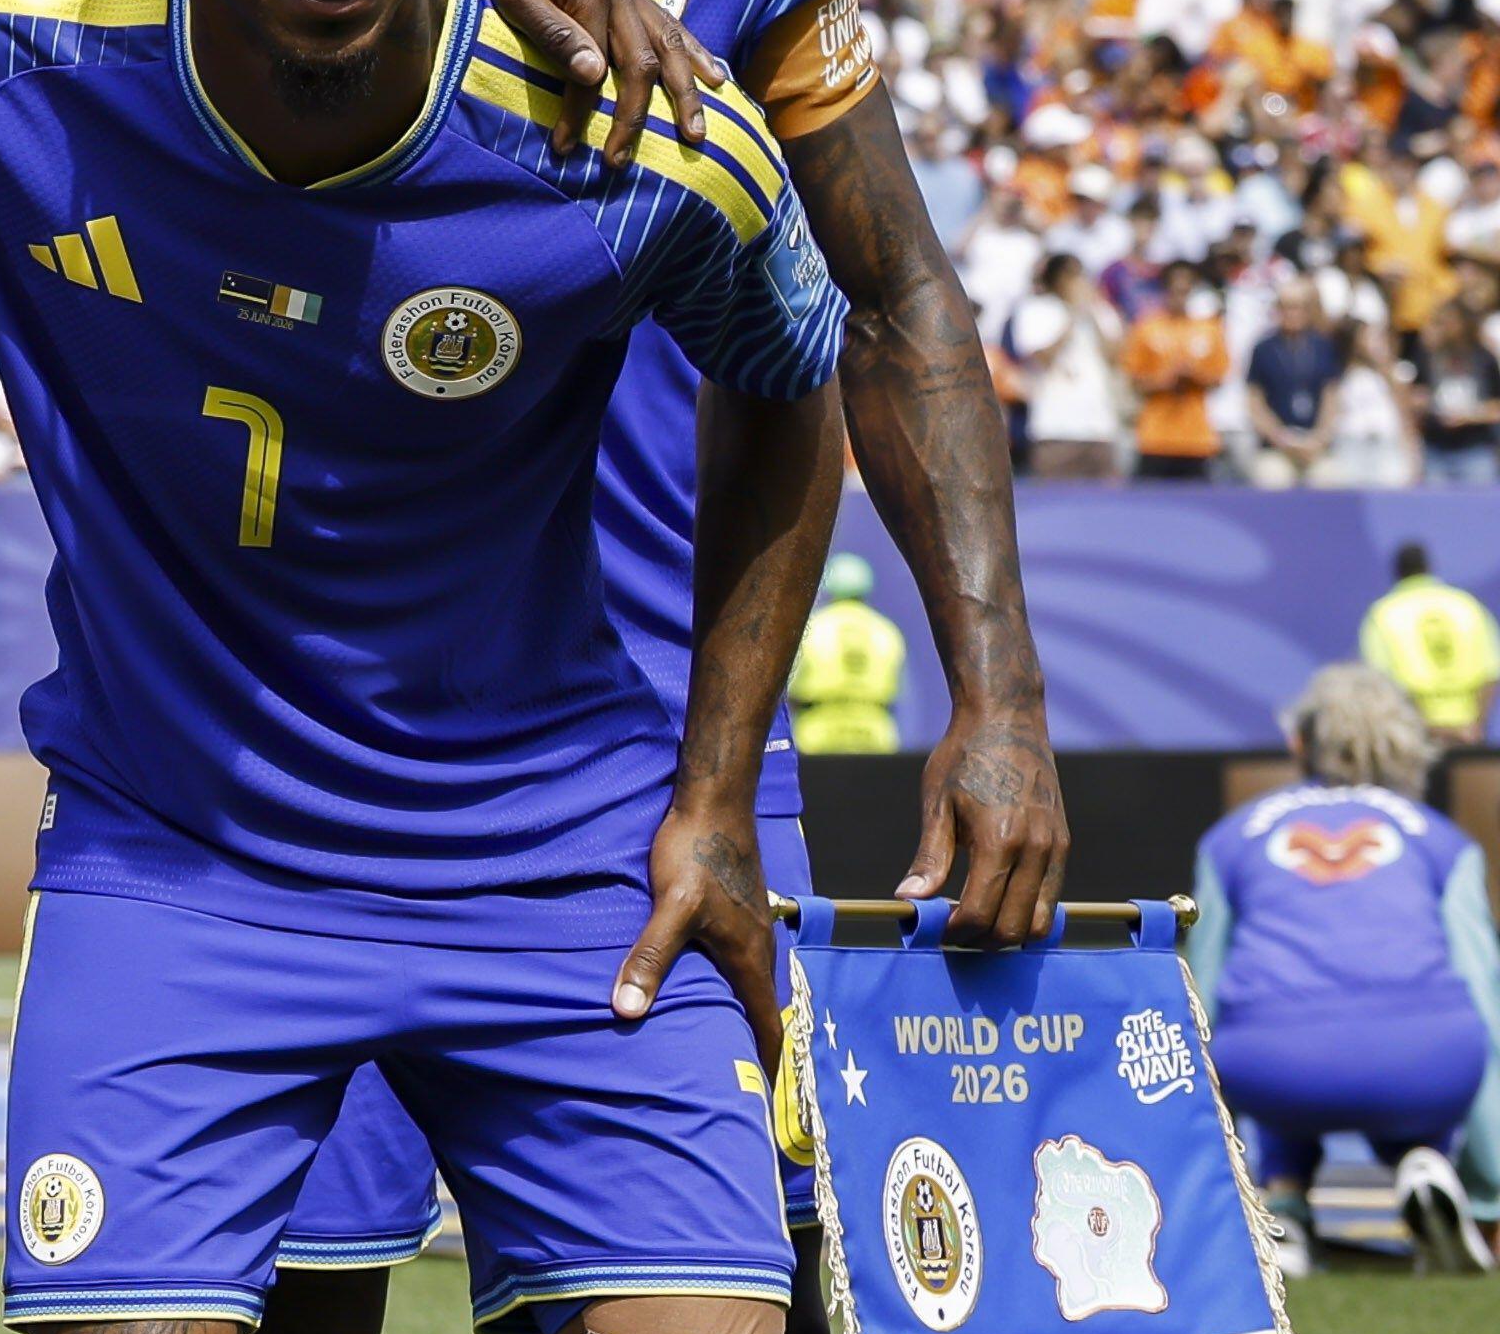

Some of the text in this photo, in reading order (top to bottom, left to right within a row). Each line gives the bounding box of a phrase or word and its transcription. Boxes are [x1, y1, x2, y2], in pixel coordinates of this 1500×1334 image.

[390, 296, 444, 381] Federashon
[201, 385, 285, 549] 7
[894, 1014, 1084, 1055] WORLD CUP
[1123, 1008, 1167, 1036] THE
[1116, 1023, 1187, 1063] BLUE
[951, 1063, 1029, 1104] 2026
[1117, 1049, 1196, 1091] WAVE
[890, 1159, 918, 1302] Federashon
